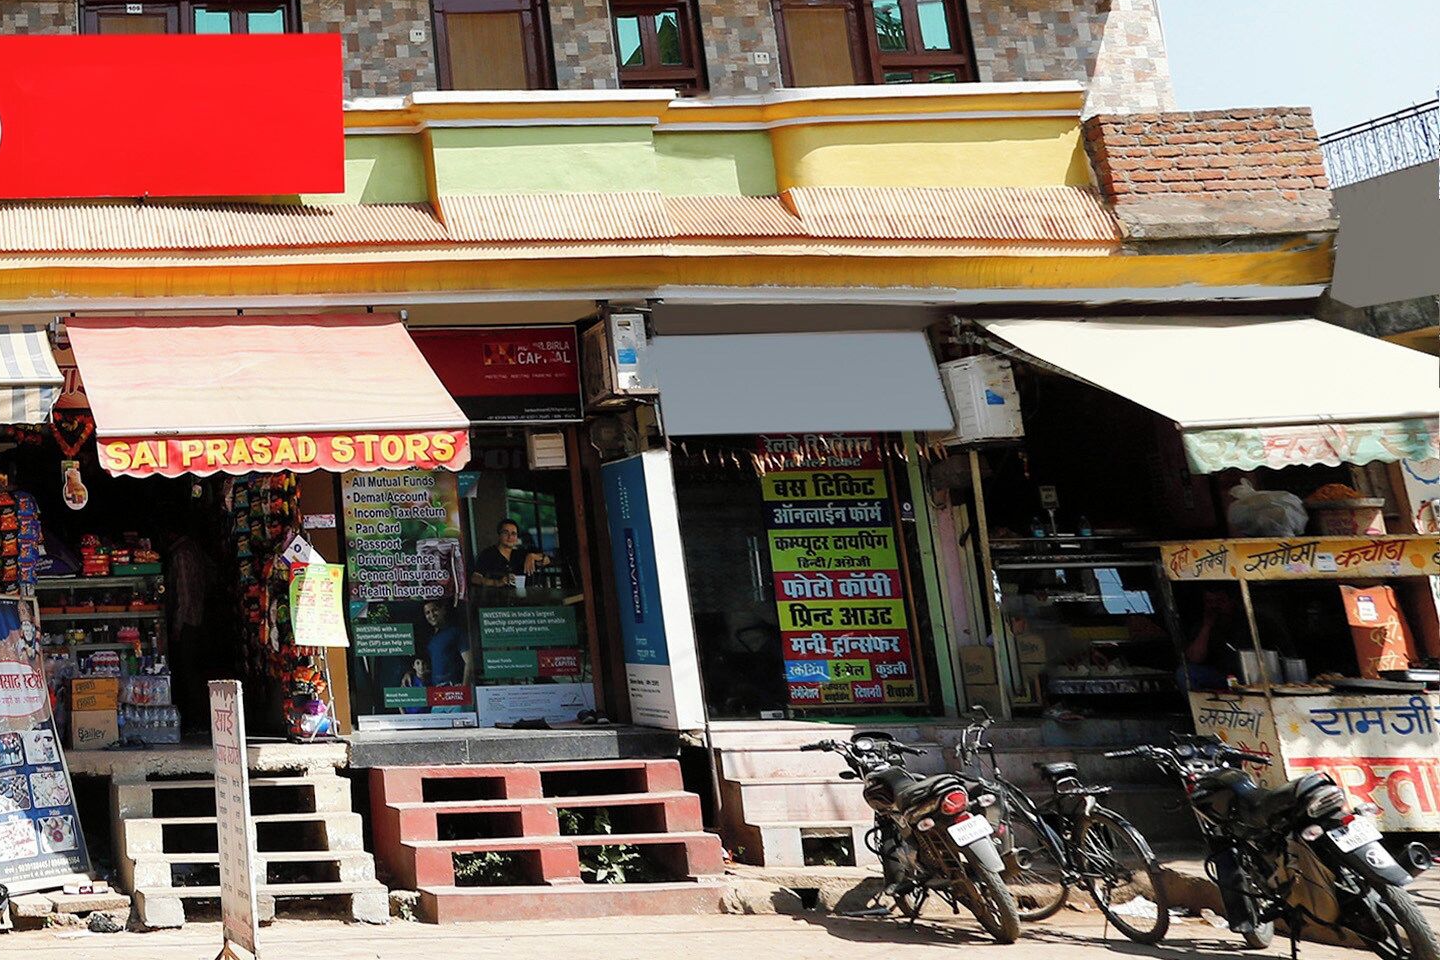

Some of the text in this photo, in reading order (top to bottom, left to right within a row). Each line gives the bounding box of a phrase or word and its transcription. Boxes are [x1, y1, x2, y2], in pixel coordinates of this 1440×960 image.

[105, 433, 456, 472] SAI PRASAD STORS
[352, 475, 435, 487] All Mutual Funds
[772, 473, 876, 497] बस टिकिट
[353, 492, 428, 503] Demat Account
[354, 506, 446, 518] Income Tax Return
[773, 501, 882, 525] ऑनलाईन फॉर्म
[355, 522, 401, 533] Pan Card
[356, 538, 402, 551] Passport
[832, 530, 888, 550] टायपिंग
[357, 553, 435, 568] Driving Licence
[359, 569, 449, 581] General Insurance
[360, 585, 444, 597] Health Insurance
[782, 572, 892, 598] फोटो कॉपी
[789, 602, 893, 628] प्रिन्ट आउट
[790, 632, 827, 655] मनी
[1310, 695, 1432, 736] रामजी
